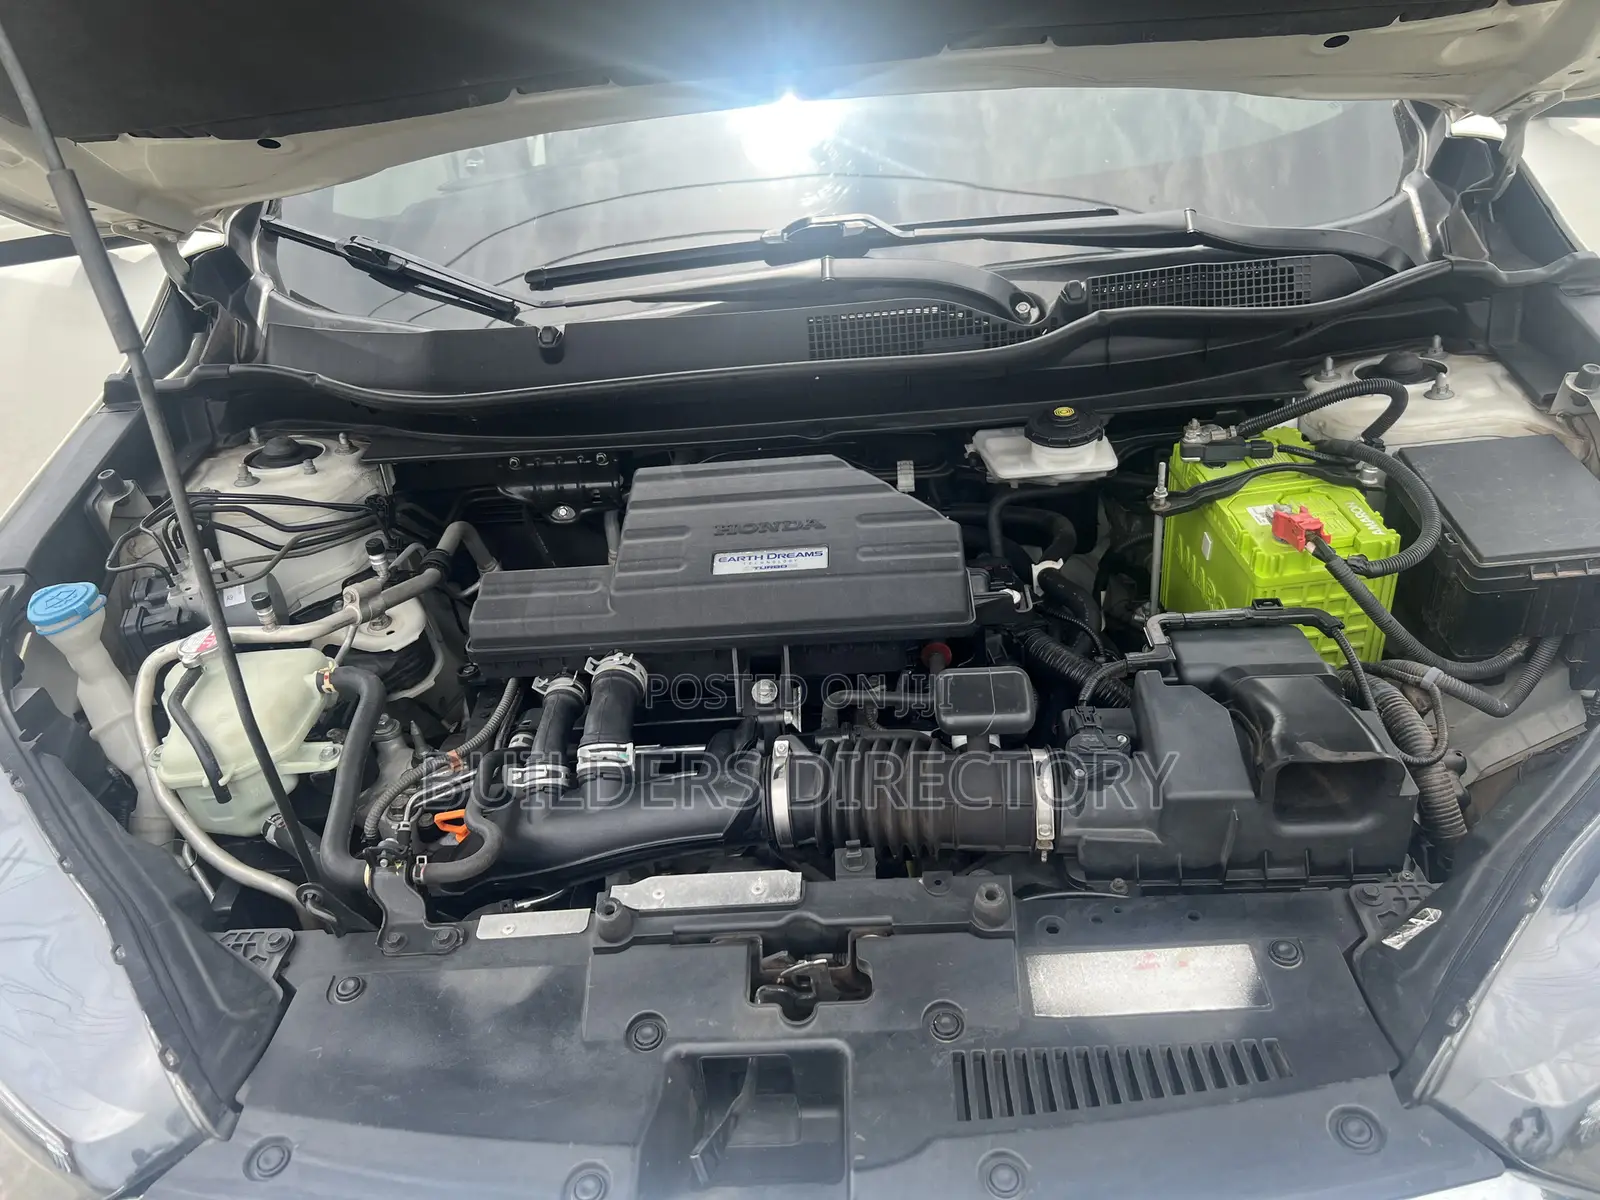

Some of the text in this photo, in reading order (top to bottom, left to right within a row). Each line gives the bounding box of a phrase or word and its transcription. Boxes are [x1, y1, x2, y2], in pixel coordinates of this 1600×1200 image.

[713, 519, 827, 536] HONDA
[1344, 501, 1387, 537] AMARON
[718, 550, 824, 563] EARTH DREAMS
